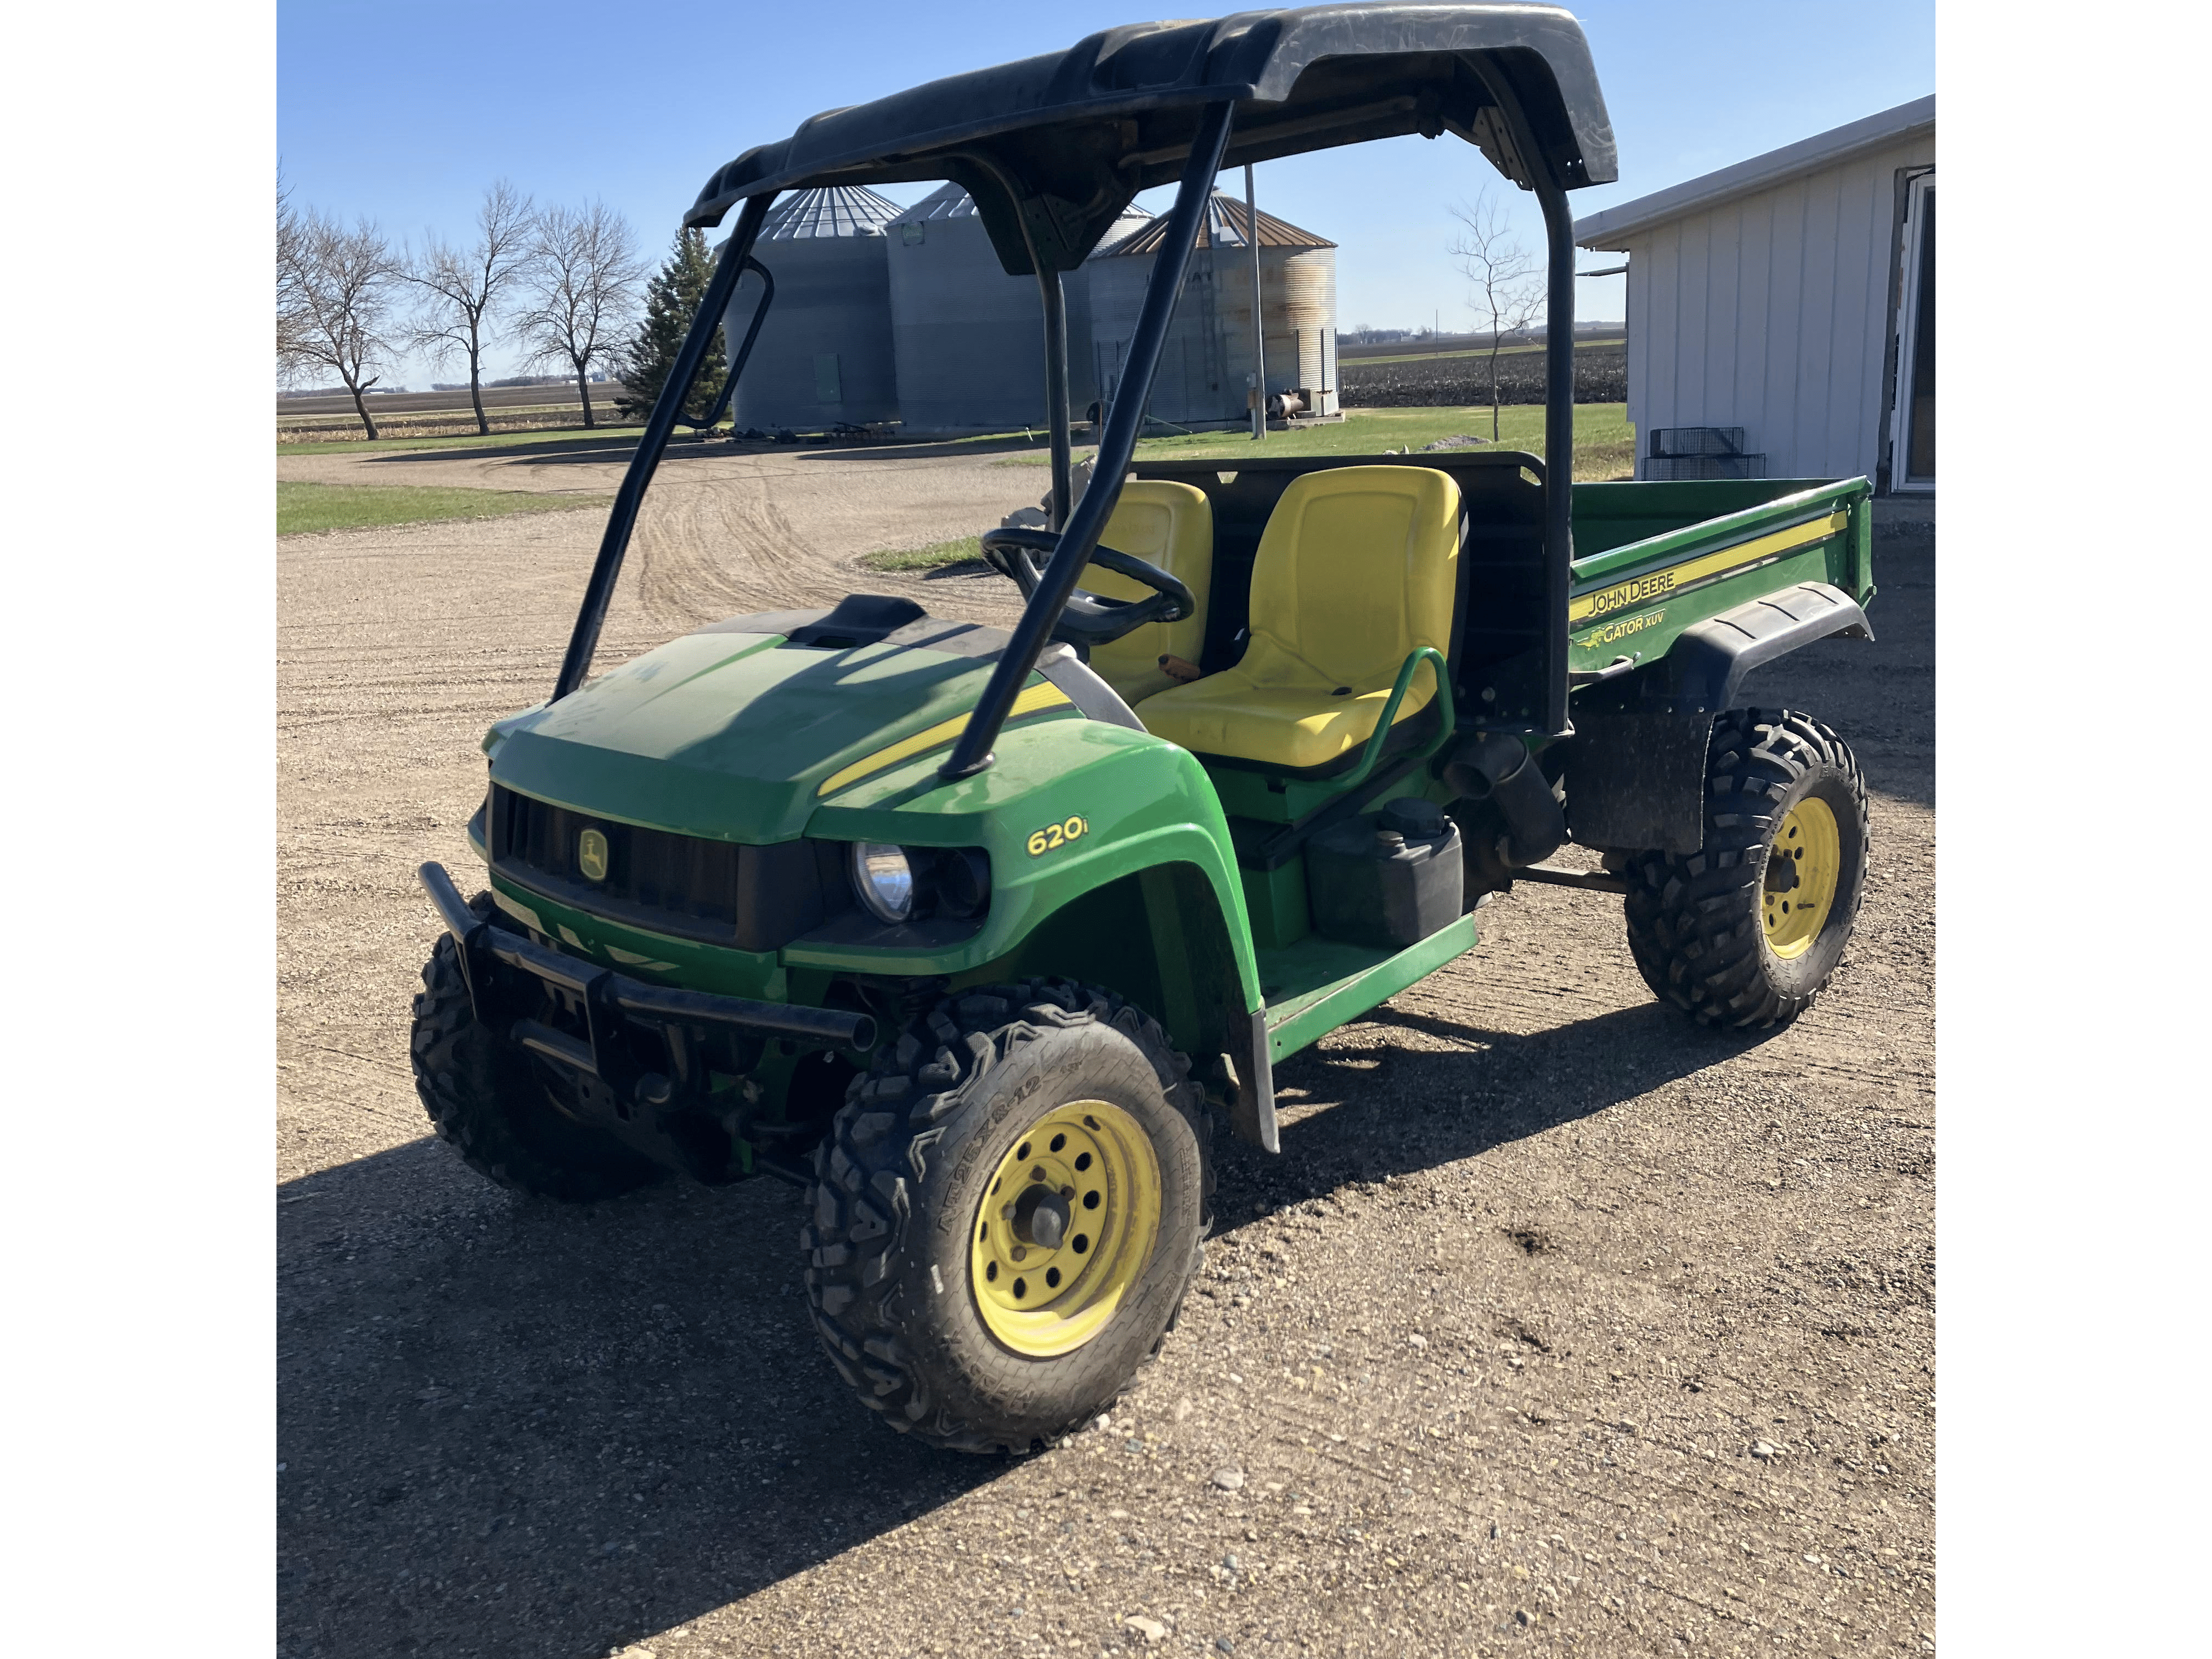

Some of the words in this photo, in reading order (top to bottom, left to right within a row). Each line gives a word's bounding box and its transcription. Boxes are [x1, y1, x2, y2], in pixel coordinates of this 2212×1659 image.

[1588, 588, 1627, 616] JOHN
[1630, 572, 1675, 601] DEERE
[1604, 617, 1643, 643] GATOR
[1645, 611, 1664, 628] XUV
